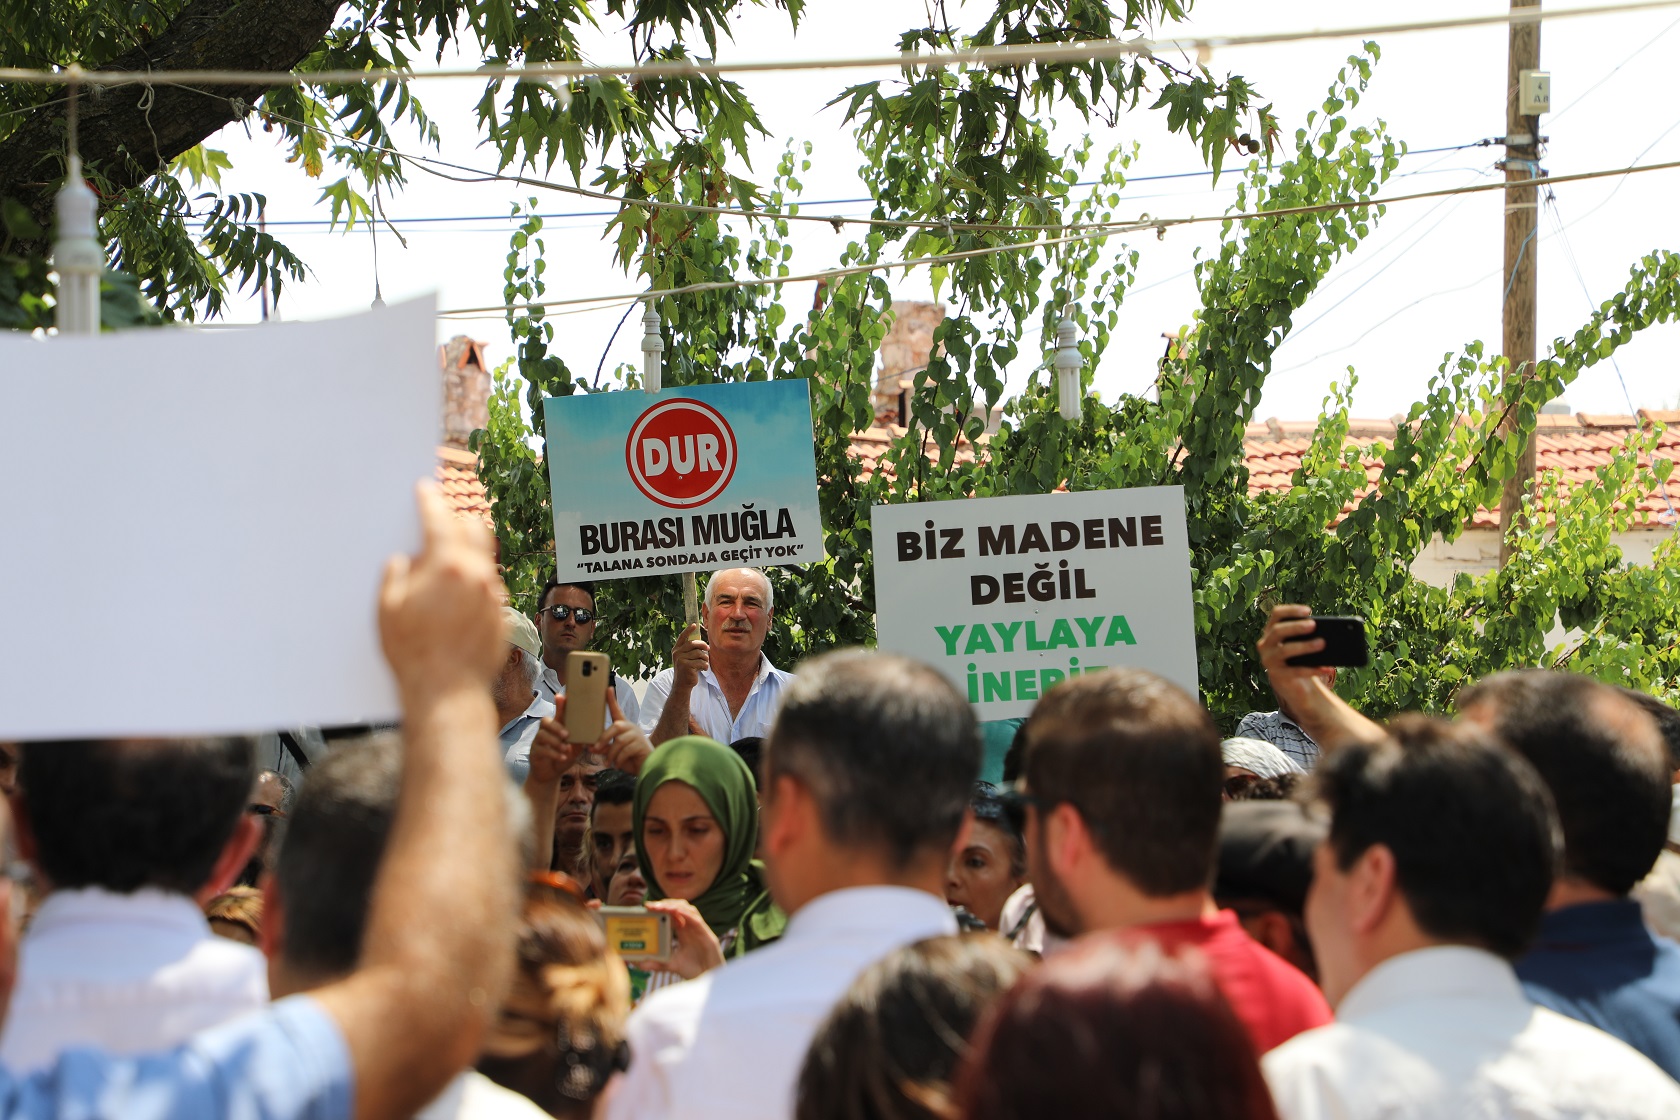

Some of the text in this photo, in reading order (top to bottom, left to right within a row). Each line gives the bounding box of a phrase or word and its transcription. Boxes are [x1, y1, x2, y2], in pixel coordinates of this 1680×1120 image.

[642, 433, 723, 477] DUR
[579, 502, 797, 556] BURASI MUĞLA
[896, 515, 1164, 562] BİZ MADENE
[646, 551, 718, 568] SONDAJA
[720, 545, 763, 564] GEÇİT
[970, 559, 1096, 606] DEĞİL
[934, 614, 1137, 656] YAYLAYA
